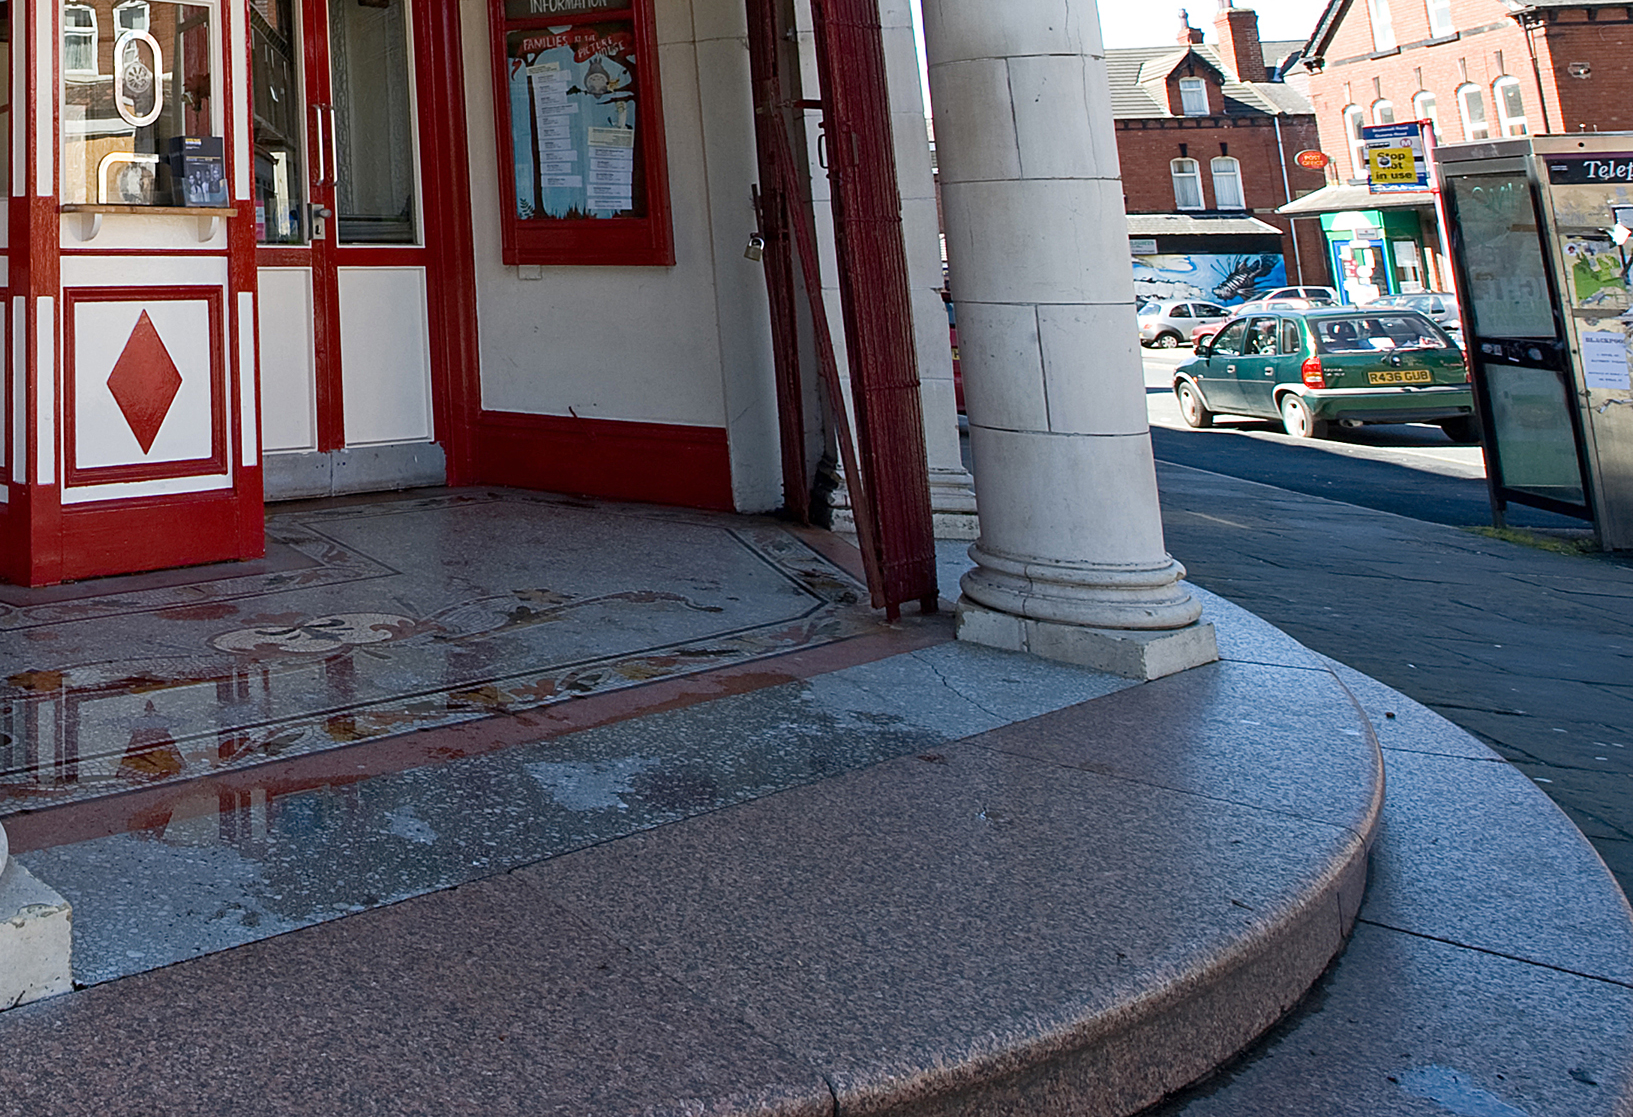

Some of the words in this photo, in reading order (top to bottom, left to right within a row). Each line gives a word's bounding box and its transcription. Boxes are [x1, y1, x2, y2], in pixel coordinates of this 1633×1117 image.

[523, 35, 569, 51] FAMILIES
[577, 36, 613, 58] PICTURE
[1381, 162, 1404, 170] ot
[1376, 171, 1387, 179] in
[1391, 172, 1413, 180] use
[1369, 371, 1403, 383] R436
